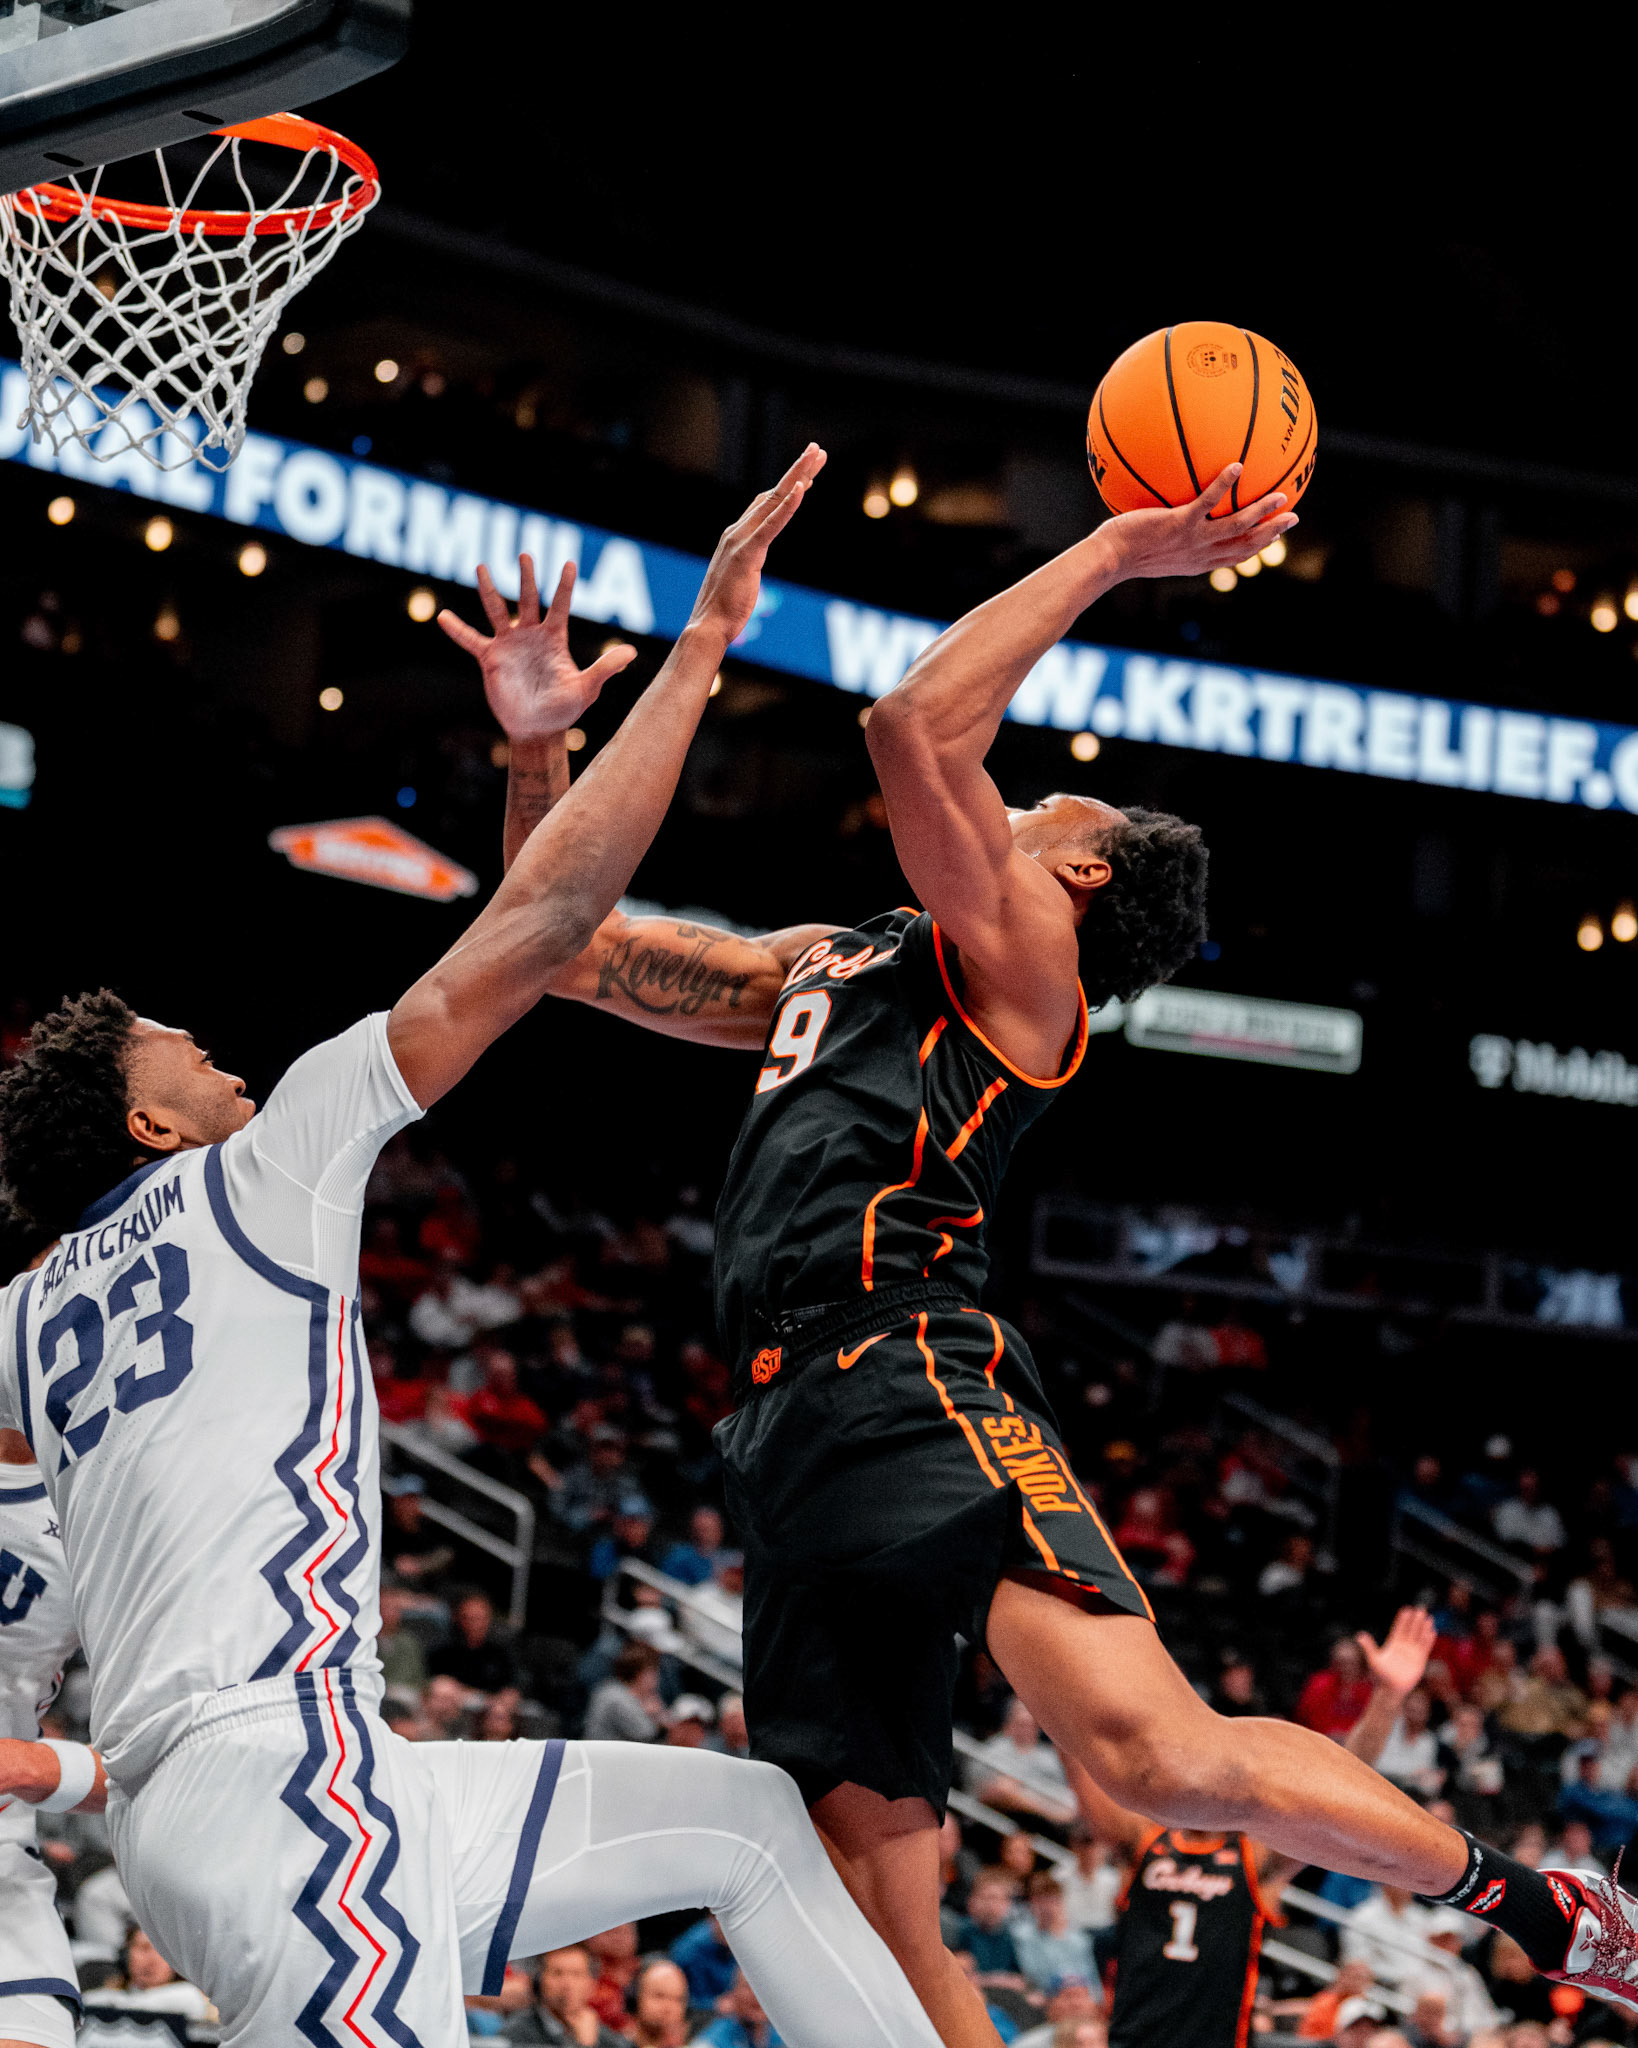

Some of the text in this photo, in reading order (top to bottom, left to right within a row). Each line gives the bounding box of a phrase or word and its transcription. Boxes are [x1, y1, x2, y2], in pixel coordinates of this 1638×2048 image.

[223, 430, 656, 635] FORMULA
[755, 988, 832, 1095] 9
[38, 1241, 194, 1477] 23
[752, 1346, 782, 1384] OSU
[982, 1415, 1082, 1513] POKES
[1162, 1900, 1199, 1962] 1
